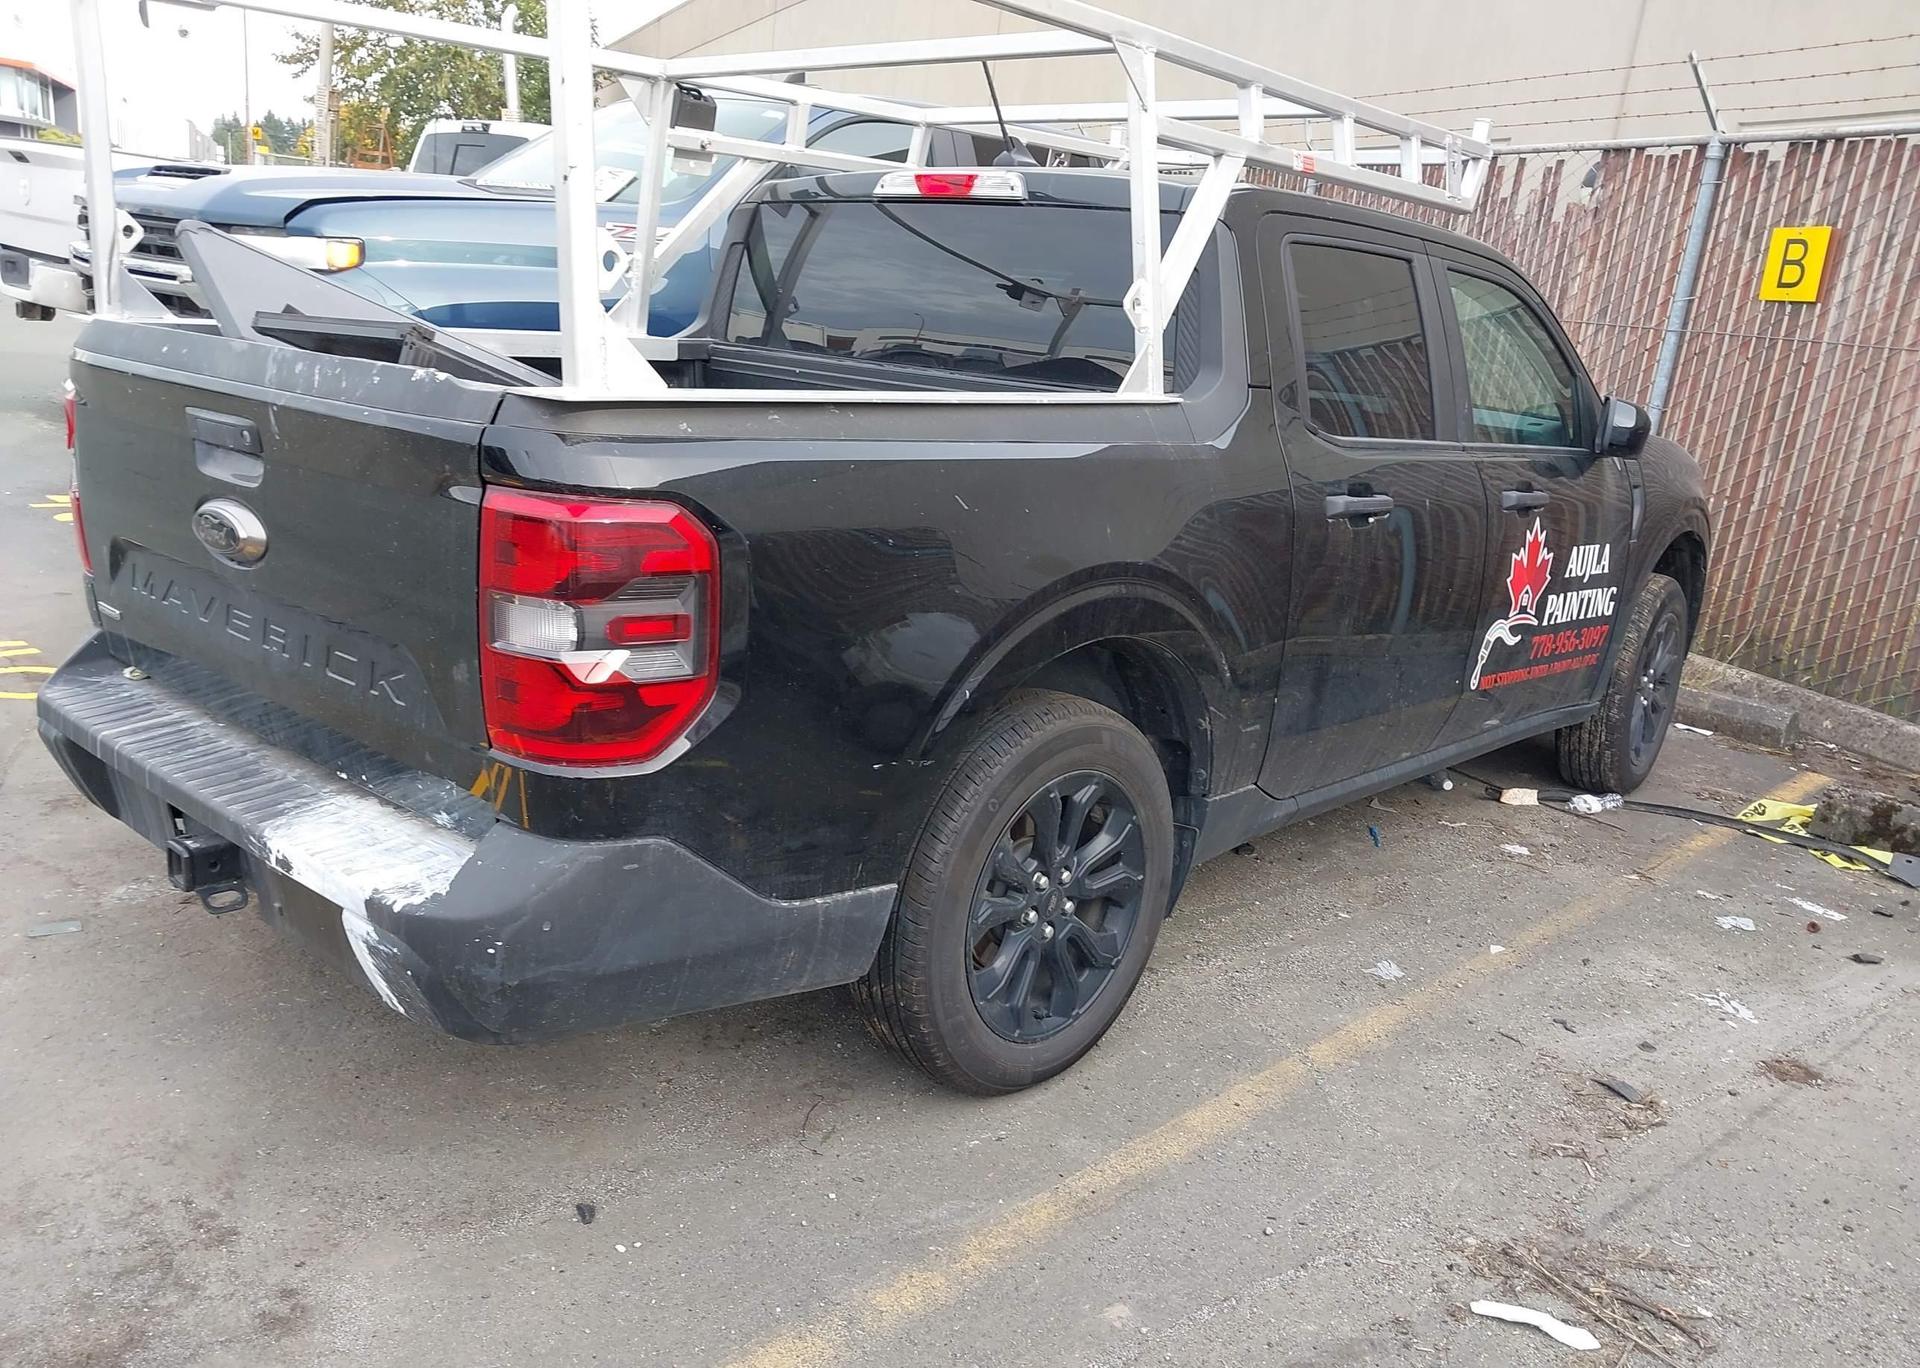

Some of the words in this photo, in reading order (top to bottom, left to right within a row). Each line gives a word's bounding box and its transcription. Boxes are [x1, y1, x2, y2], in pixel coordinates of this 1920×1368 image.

[1776, 238, 1808, 289] B
[1564, 543, 1610, 583] AUJLA
[1542, 586, 1617, 626] PAINTING
[130, 562, 406, 706] MAVERICK
[1530, 624, 1610, 660] 778-956-3097
